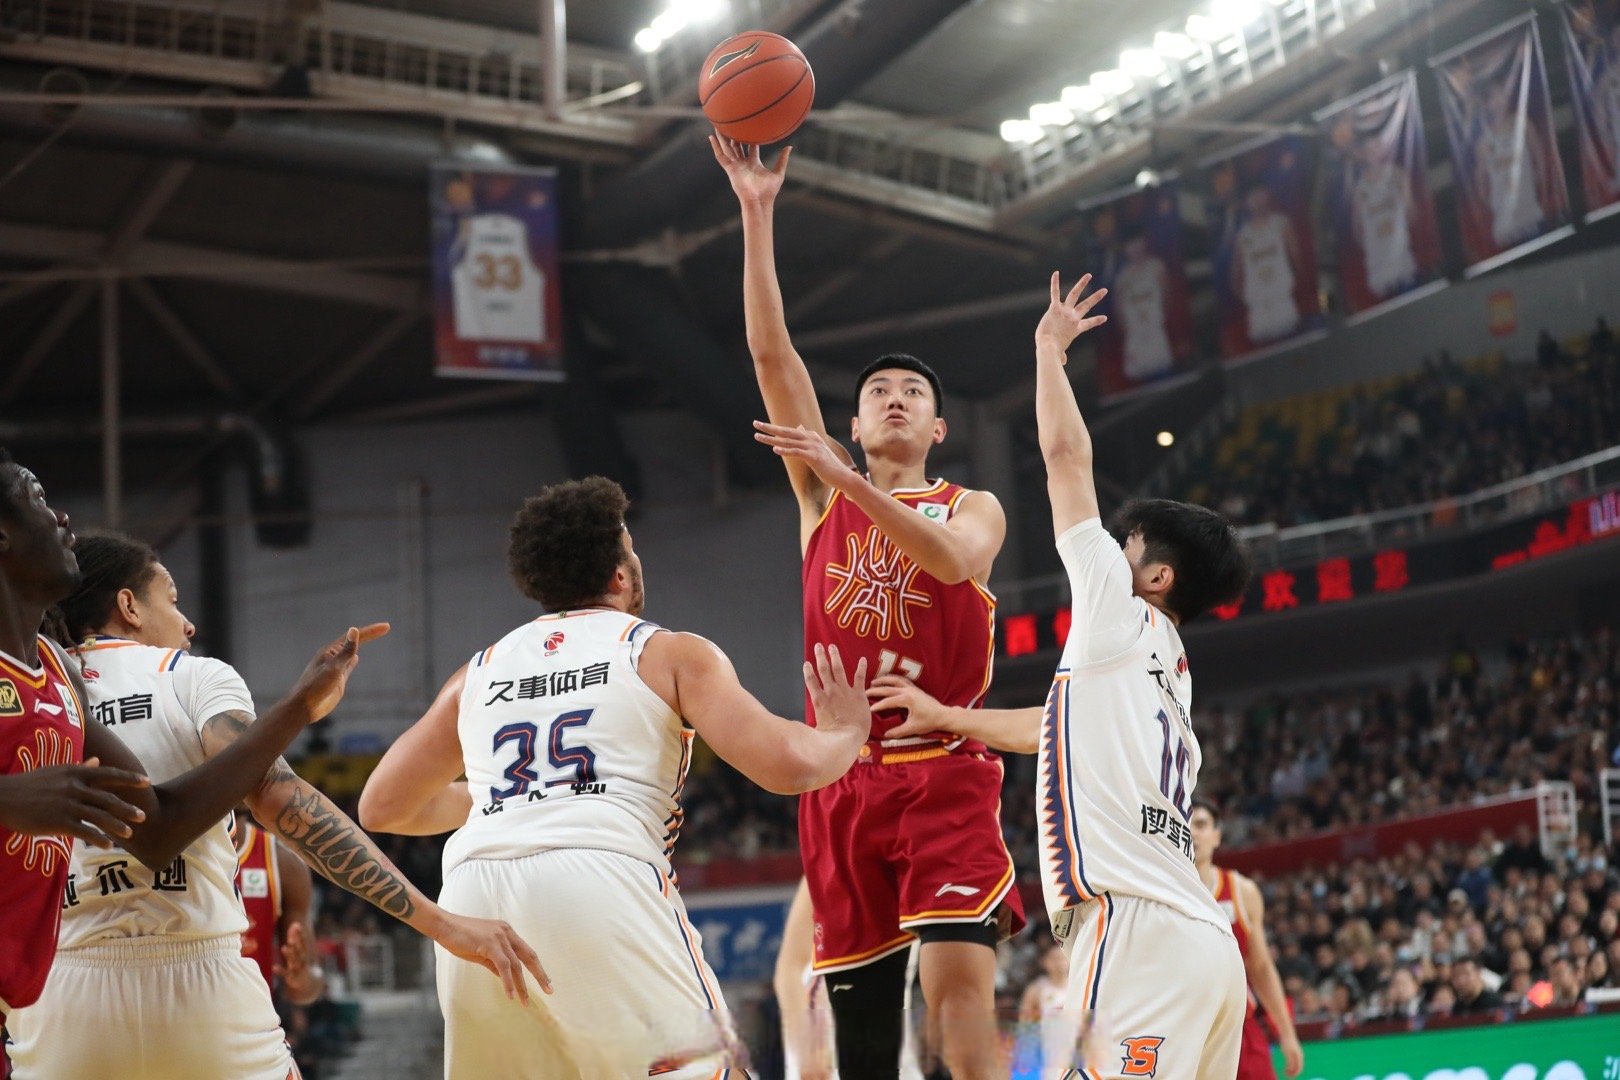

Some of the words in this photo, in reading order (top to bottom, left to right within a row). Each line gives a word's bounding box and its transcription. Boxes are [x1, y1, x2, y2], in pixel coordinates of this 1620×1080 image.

[474, 252, 523, 291] 33
[485, 661, 610, 706] 久事体育
[490, 707, 598, 803] 35
